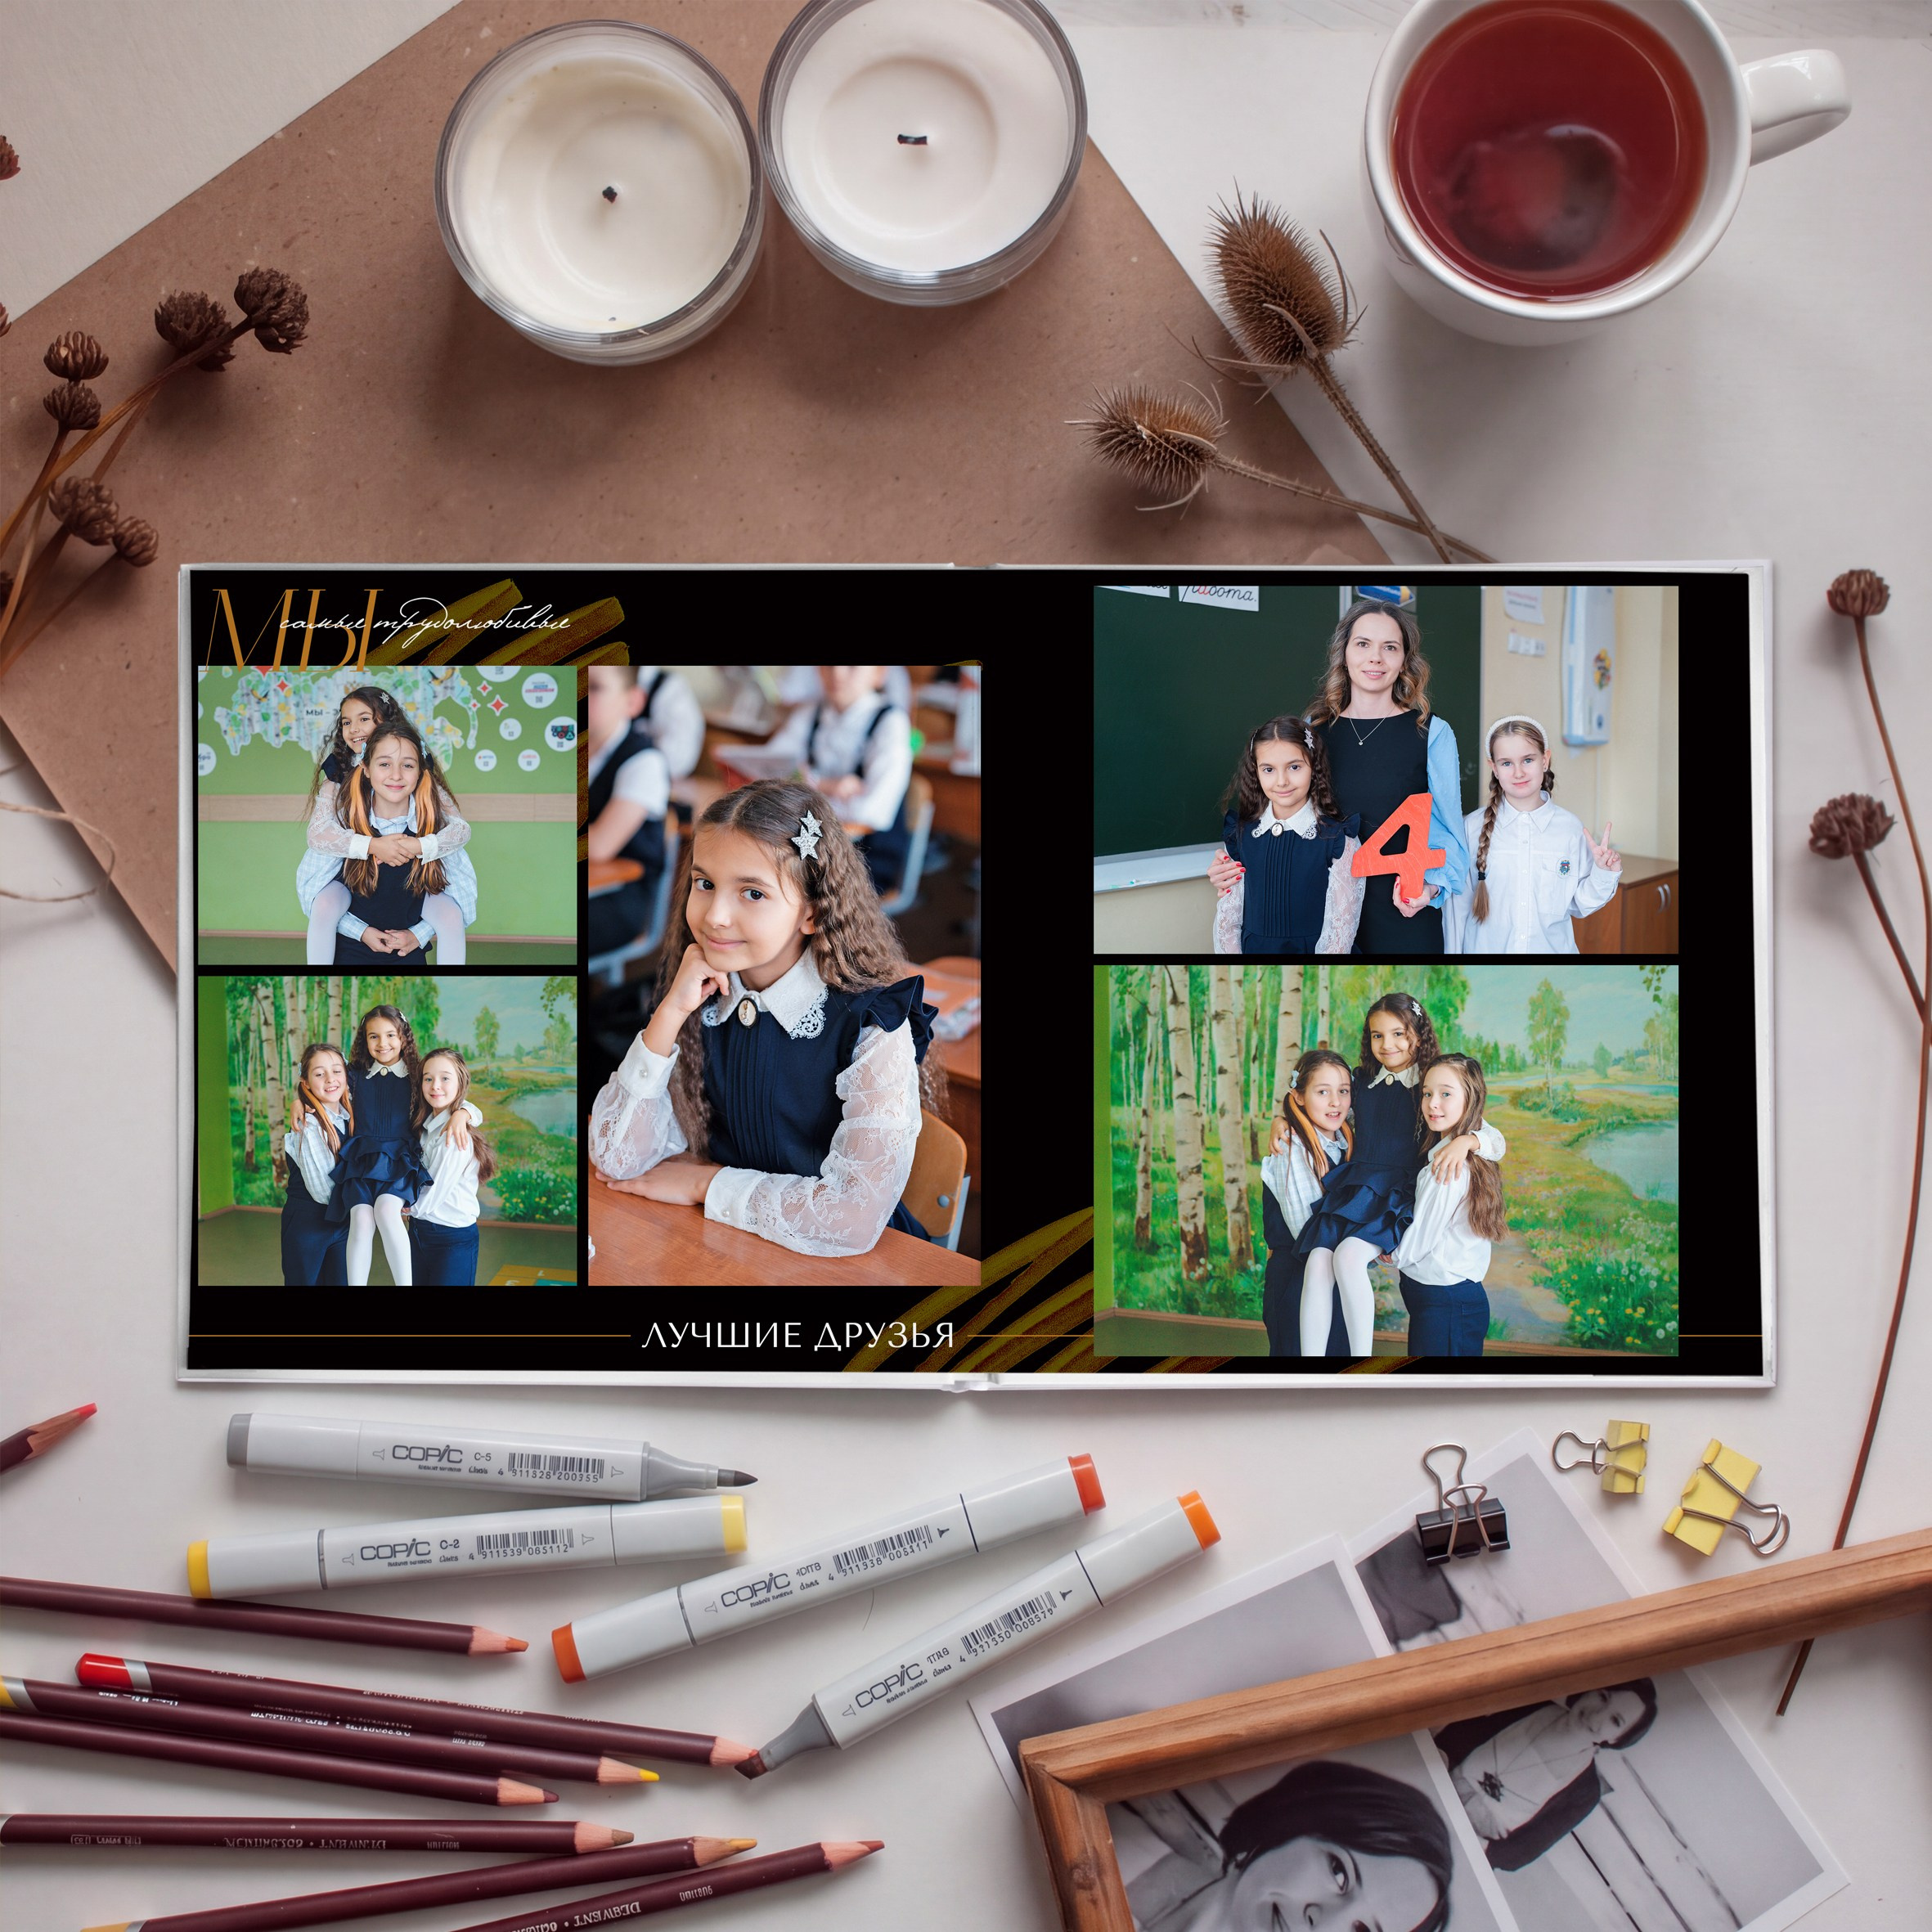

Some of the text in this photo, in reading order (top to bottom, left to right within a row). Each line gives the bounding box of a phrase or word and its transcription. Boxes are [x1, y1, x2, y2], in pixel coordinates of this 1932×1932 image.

[279, 597, 572, 649] самые трудолюбивые
[1351, 793, 1445, 899] 4
[641, 1322, 954, 1352] ЛУЧШИЕ ДРУЗЬЯ
[474, 1452, 492, 1462] C-5
[439, 1539, 460, 1550] C-2
